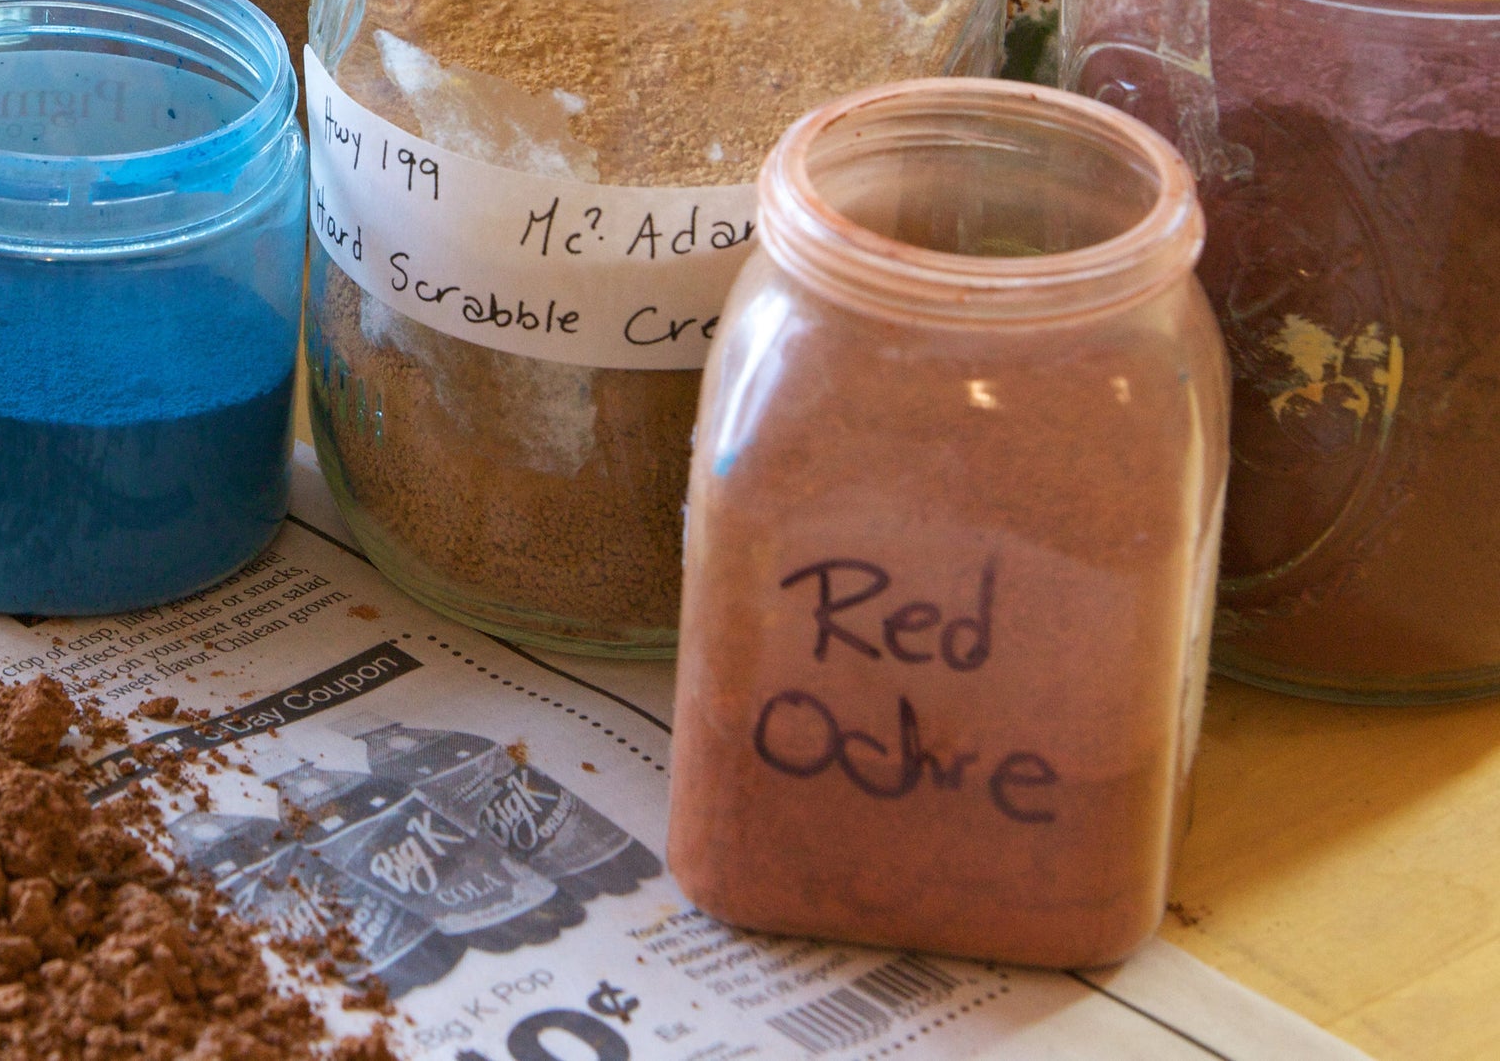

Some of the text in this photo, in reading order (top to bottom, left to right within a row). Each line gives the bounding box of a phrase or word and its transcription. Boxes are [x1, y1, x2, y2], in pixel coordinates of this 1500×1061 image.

[324, 95, 363, 170] Hwy
[381, 138, 441, 200] 199
[316, 185, 362, 262] Hard
[389, 252, 581, 334] Scrabble
[2, 655, 47, 678] crop
[45, 644, 70, 662] of
[68, 626, 120, 653] crisp,
[113, 604, 165, 631] juicy
[58, 643, 124, 678] perfect
[119, 628, 153, 647] for
[150, 603, 223, 638] lunches
[221, 593, 245, 609] or
[243, 564, 311, 599] snacks,
[105, 589, 354, 702] sweet flavor. Chilean grown.
[116, 656, 146, 676] on
[141, 636, 190, 664] your
[188, 619, 235, 645] next
[230, 597, 287, 628] green
[281, 573, 333, 603] salad
[780, 553, 997, 672] Red
[281, 653, 400, 715] Coupon
[753, 689, 1059, 825] Ochre
[370, 811, 466, 895] Big K
[435, 871, 508, 907] COLA
[461, 996, 499, 1023] K
[491, 967, 555, 1007] Pop
